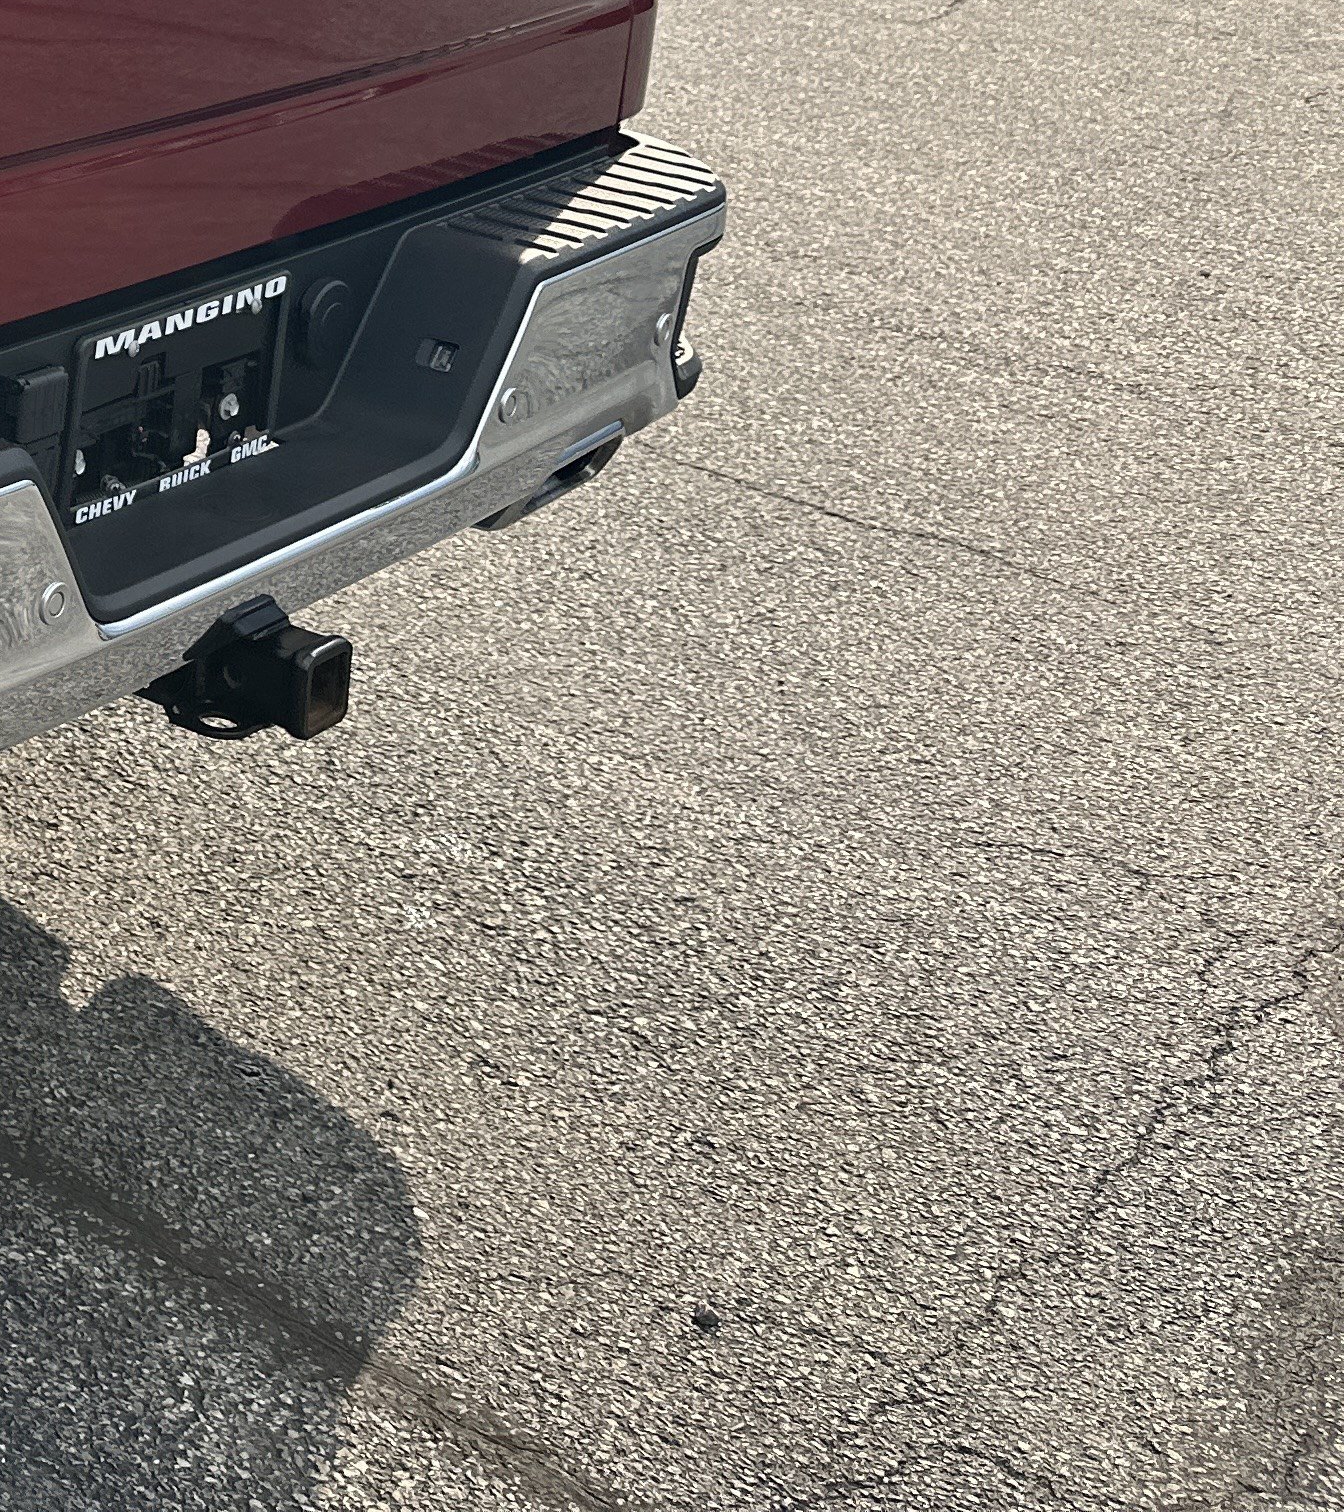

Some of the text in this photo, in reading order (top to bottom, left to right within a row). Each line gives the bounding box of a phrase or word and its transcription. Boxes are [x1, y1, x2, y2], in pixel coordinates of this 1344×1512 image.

[94, 275, 288, 360] MANGINO
[74, 434, 269, 525] CHEVY BUICK GMC
